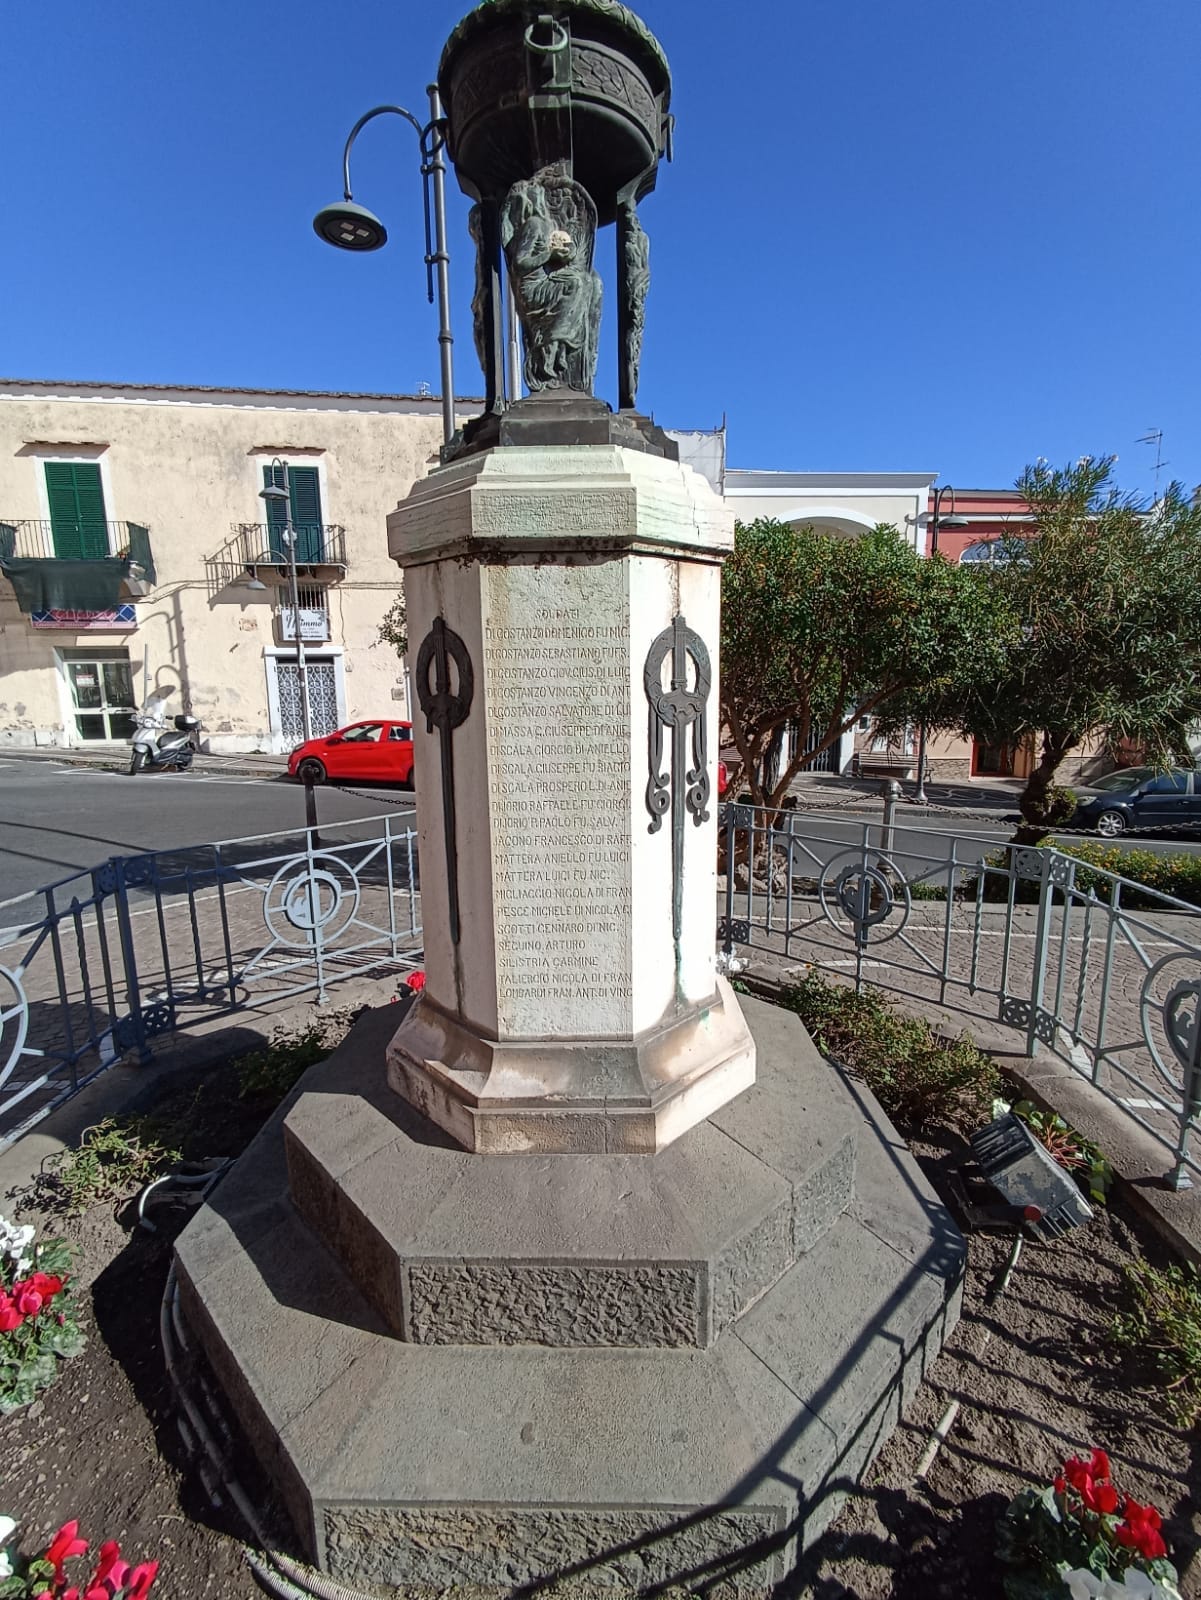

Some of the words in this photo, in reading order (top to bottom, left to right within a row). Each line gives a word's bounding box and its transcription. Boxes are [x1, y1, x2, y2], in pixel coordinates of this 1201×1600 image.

[536, 609, 580, 619] SOLDATI
[496, 627, 544, 640] COSTANZO
[544, 626, 595, 639] DOMENICO
[496, 648, 542, 660] COSTANZO
[542, 647, 600, 659] SEBASTIANO
[498, 668, 548, 679] COSTANZO
[498, 687, 546, 698] COSTANZO
[548, 686, 598, 697] VINCENZO
[498, 706, 546, 718] COSTANZO
[550, 705, 602, 717] SALVATORE
[500, 726, 534, 737] MASSA
[500, 745, 534, 756] SCALA
[534, 744, 572, 755] GIORGIO
[587, 743, 630, 754] ANIELLO
[502, 763, 534, 775] SCALA
[535, 762, 580, 774] GIUSEPPE
[598, 761, 631, 773] BIAGIO
[501, 781, 534, 793] SCALA
[536, 780, 587, 792] PROSPERO
[528, 800, 580, 811] RAFFAELE
[534, 835, 594, 846] FRANCESCO
[495, 854, 541, 865] MATTERA
[544, 852, 586, 863] ANIELLO
[604, 851, 630, 862] LUIGI
[495, 871, 543, 882] MATTERA
[545, 870, 571, 881] LUIGI
[495, 888, 552, 899] MIGLIACCIO
[554, 887, 594, 898] NICOLA
[497, 907, 530, 918] PESCE
[531, 906, 572, 917] MICHELE
[586, 904, 620, 915] NICOLA
[498, 924, 536, 935] SCOTTI
[537, 923, 584, 934] GENNARO
[545, 939, 586, 950] ARTURO
[498, 957, 550, 968] SILISTRIA
[552, 956, 599, 967] CARMINE
[498, 974, 550, 985] TALIERCIO
[552, 973, 588, 984] NICOLA
[500, 988, 546, 999] LOMBARDI
